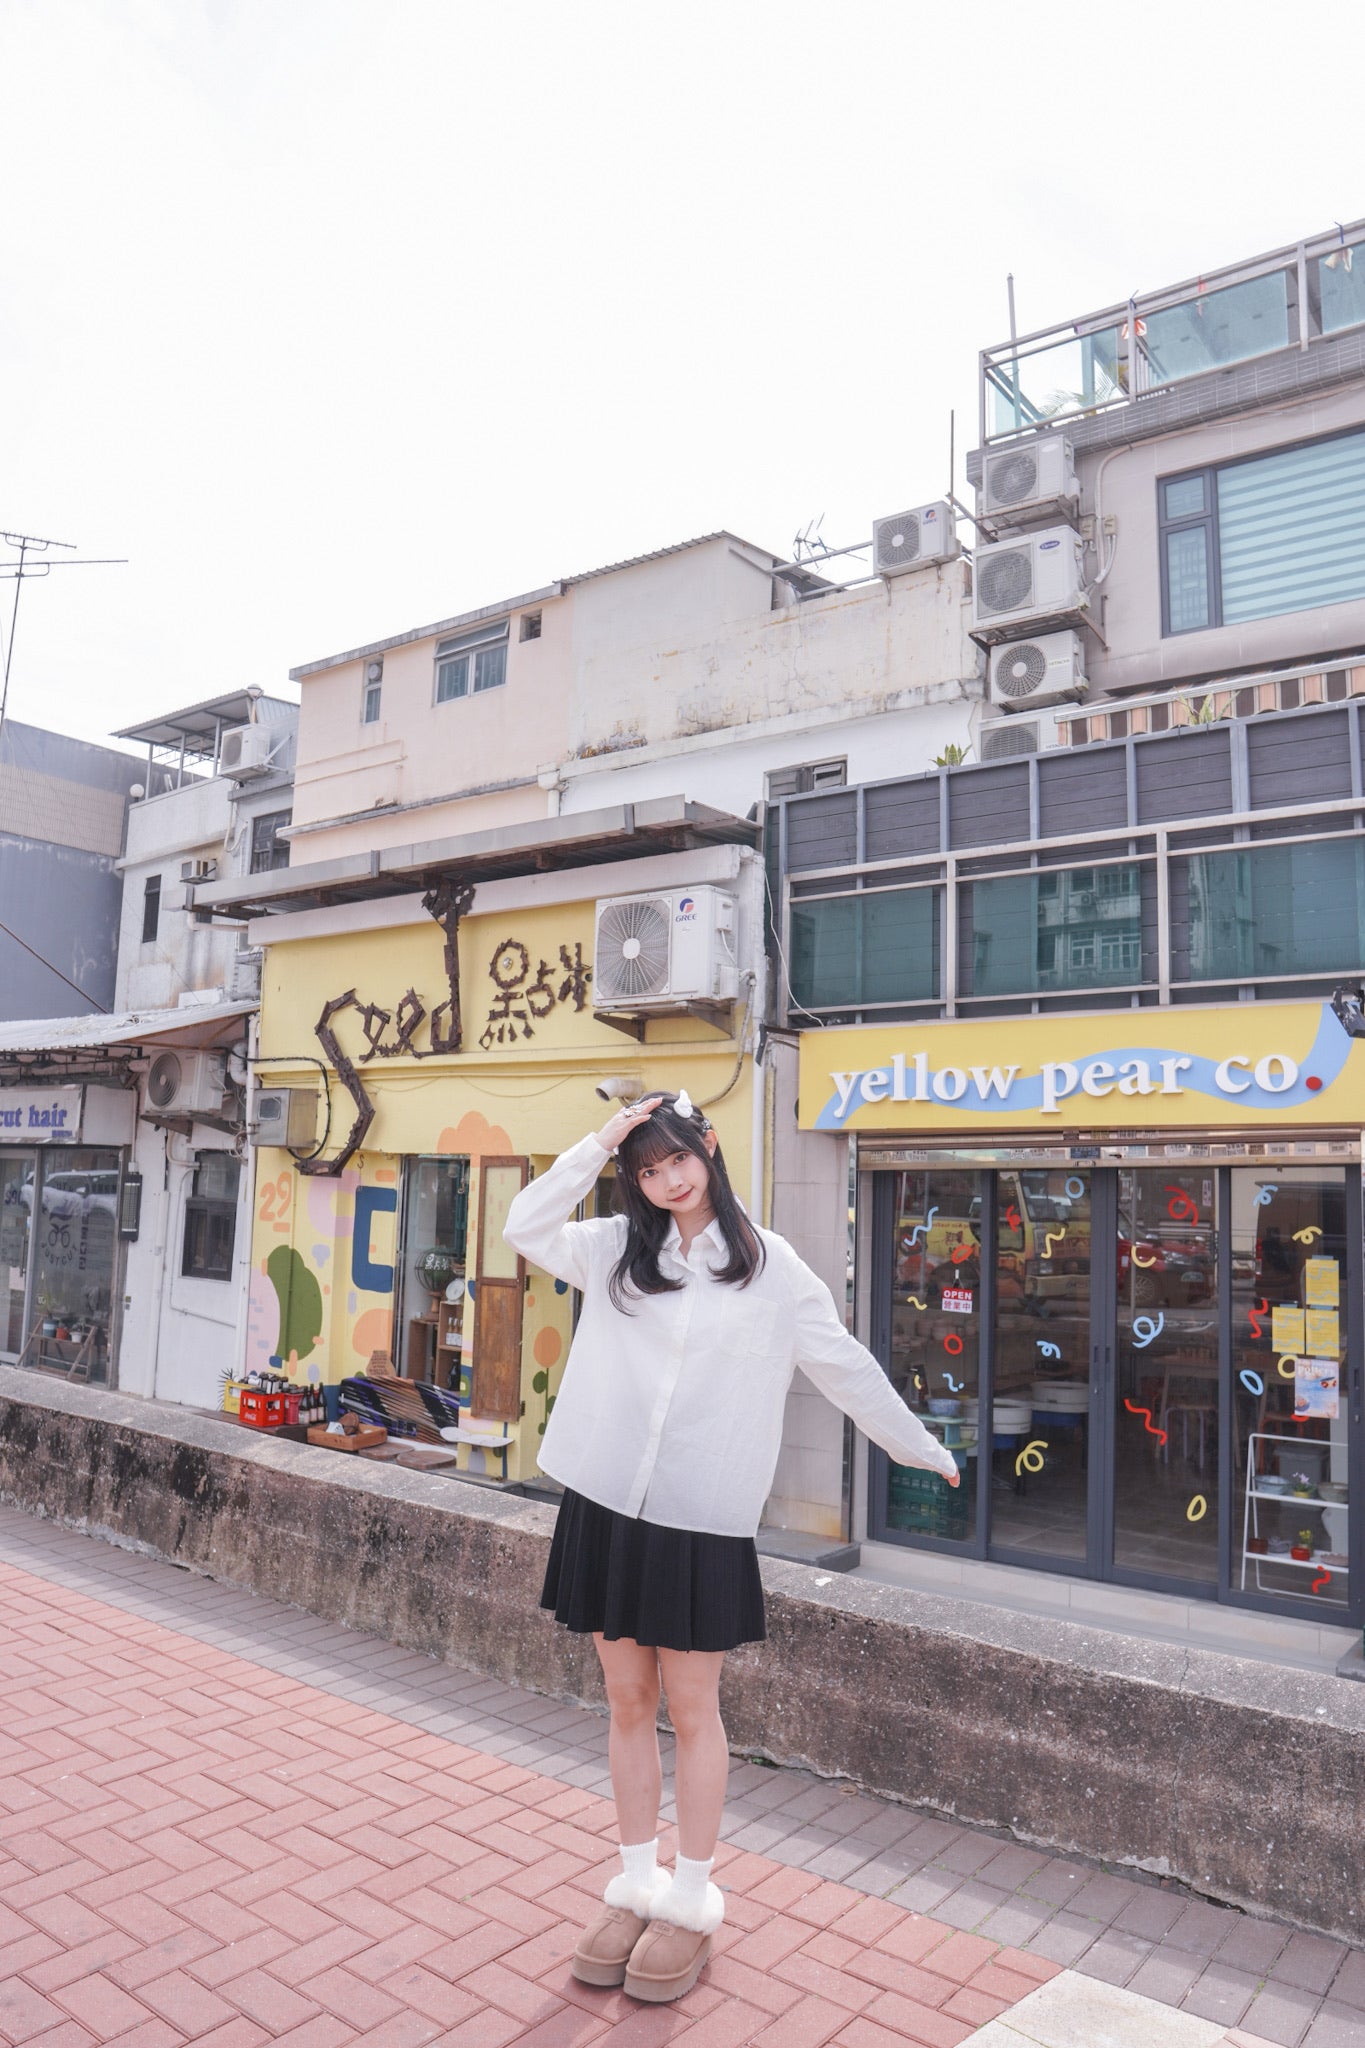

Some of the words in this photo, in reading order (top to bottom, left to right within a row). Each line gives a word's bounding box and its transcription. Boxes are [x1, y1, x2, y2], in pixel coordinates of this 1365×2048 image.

[829, 1051, 1021, 1118] yellow
[1039, 1056, 1193, 1114] pear
[1214, 1053, 1323, 1095] co.
[28, 1102, 68, 1128] hair
[259, 1171, 292, 1221] 29
[943, 1290, 972, 1300] OPEN
